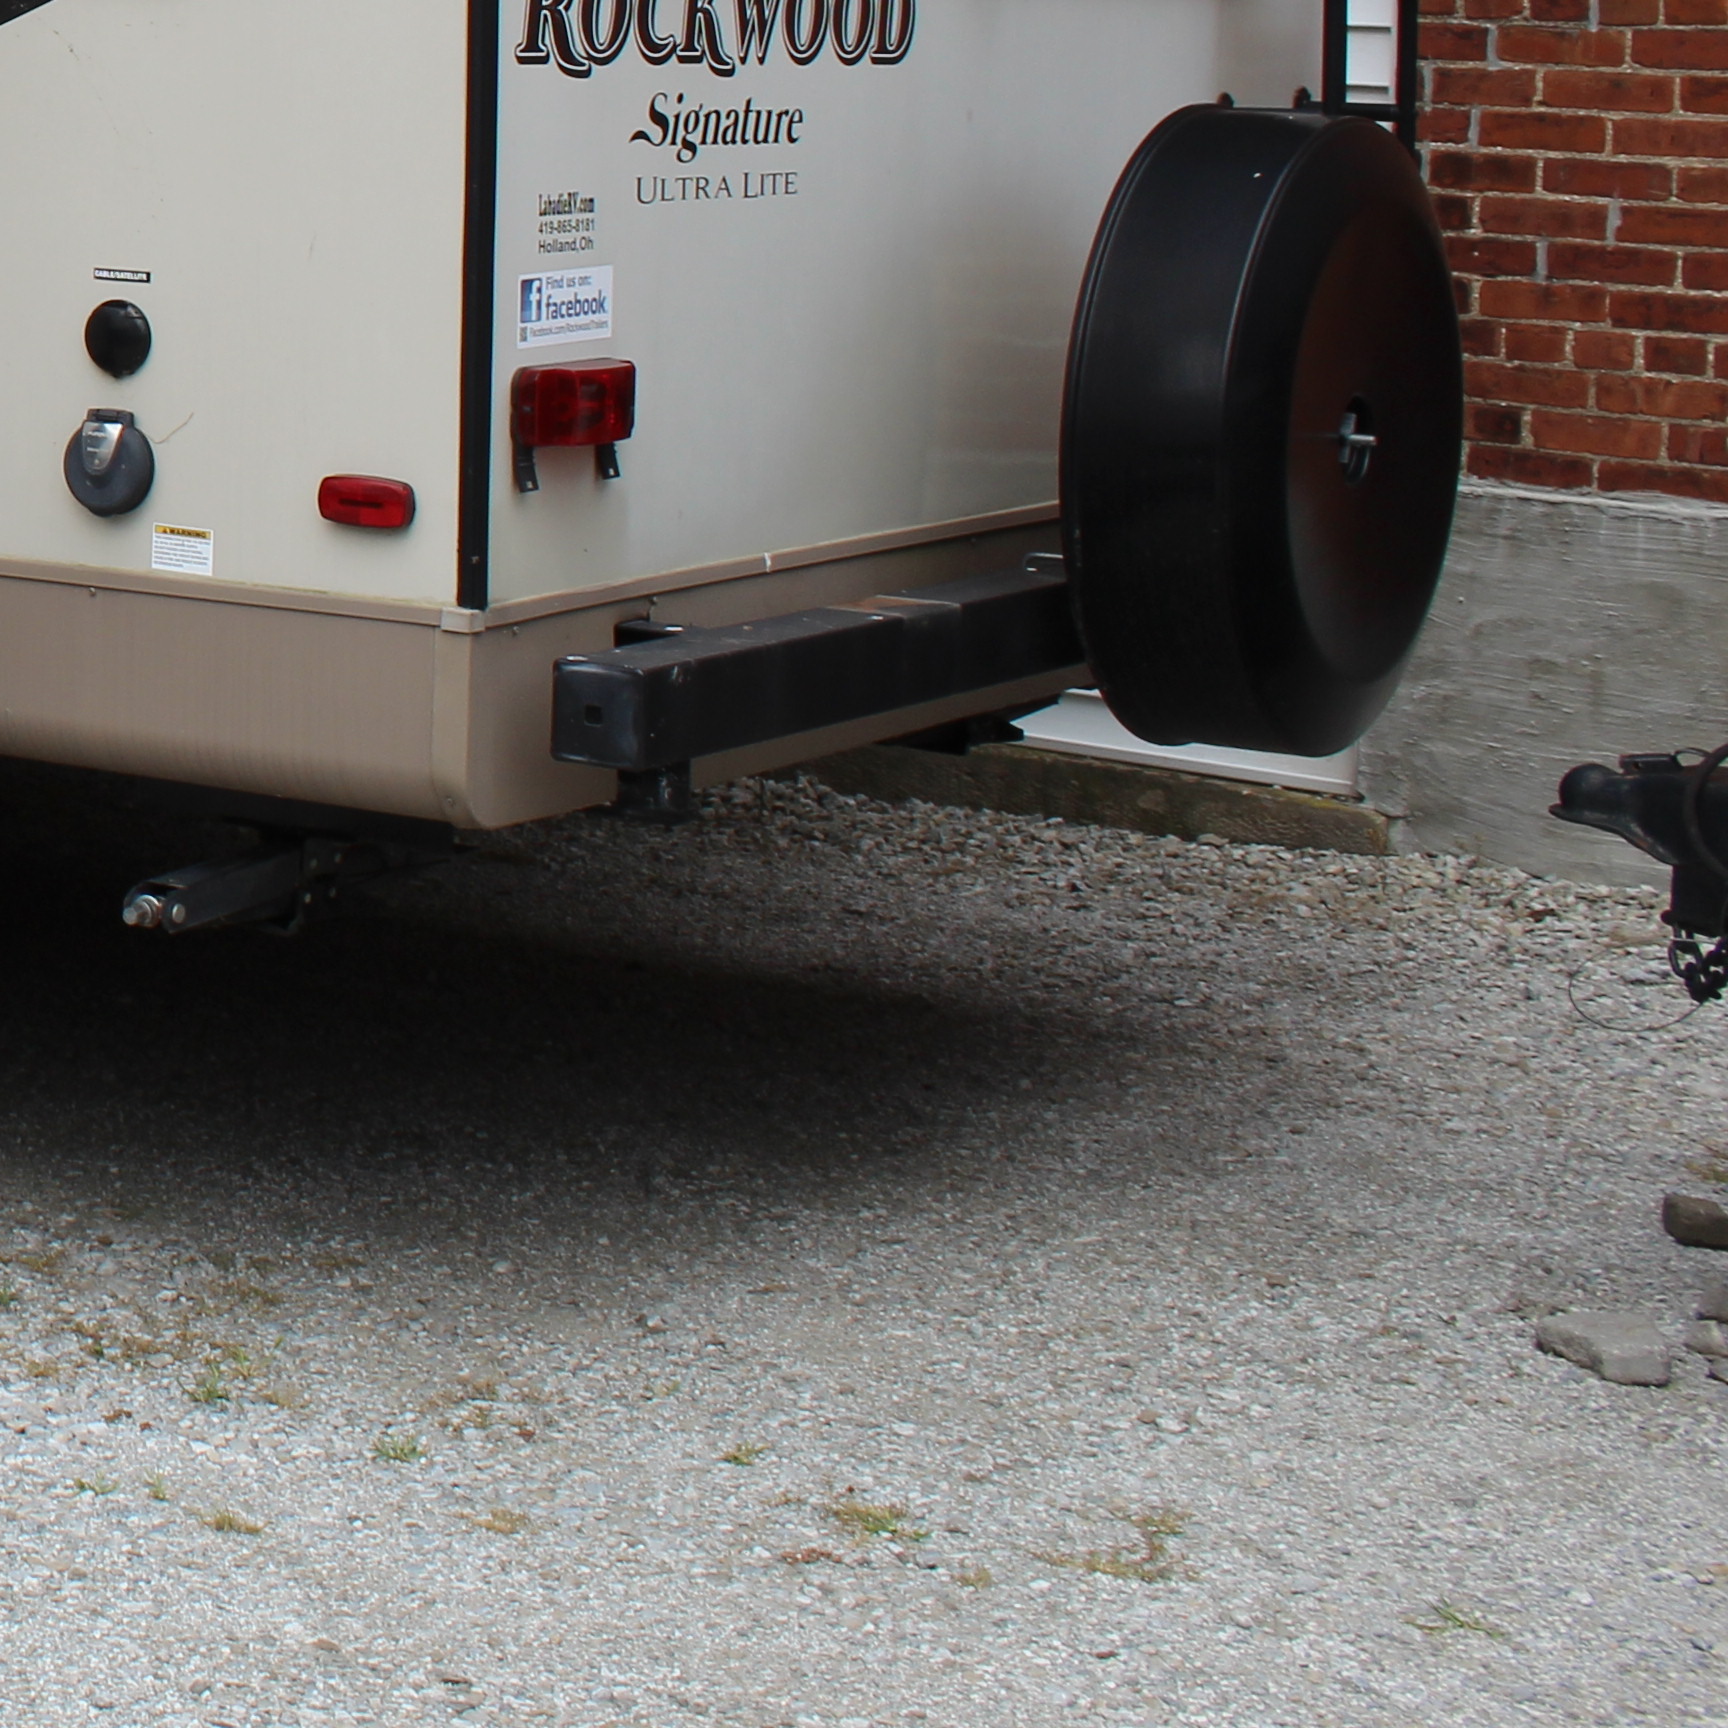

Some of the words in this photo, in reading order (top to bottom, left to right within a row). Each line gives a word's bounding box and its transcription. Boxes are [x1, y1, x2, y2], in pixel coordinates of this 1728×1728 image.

[630, 92, 804, 163] Signature
[635, 175, 733, 204] ULTRA
[742, 172, 799, 200] LITE
[538, 218, 595, 235] 419-865-8181
[545, 274, 564, 290] Find
[566, 276, 576, 287] us
[545, 289, 607, 320] facebook
[169, 527, 207, 539] WARNING
